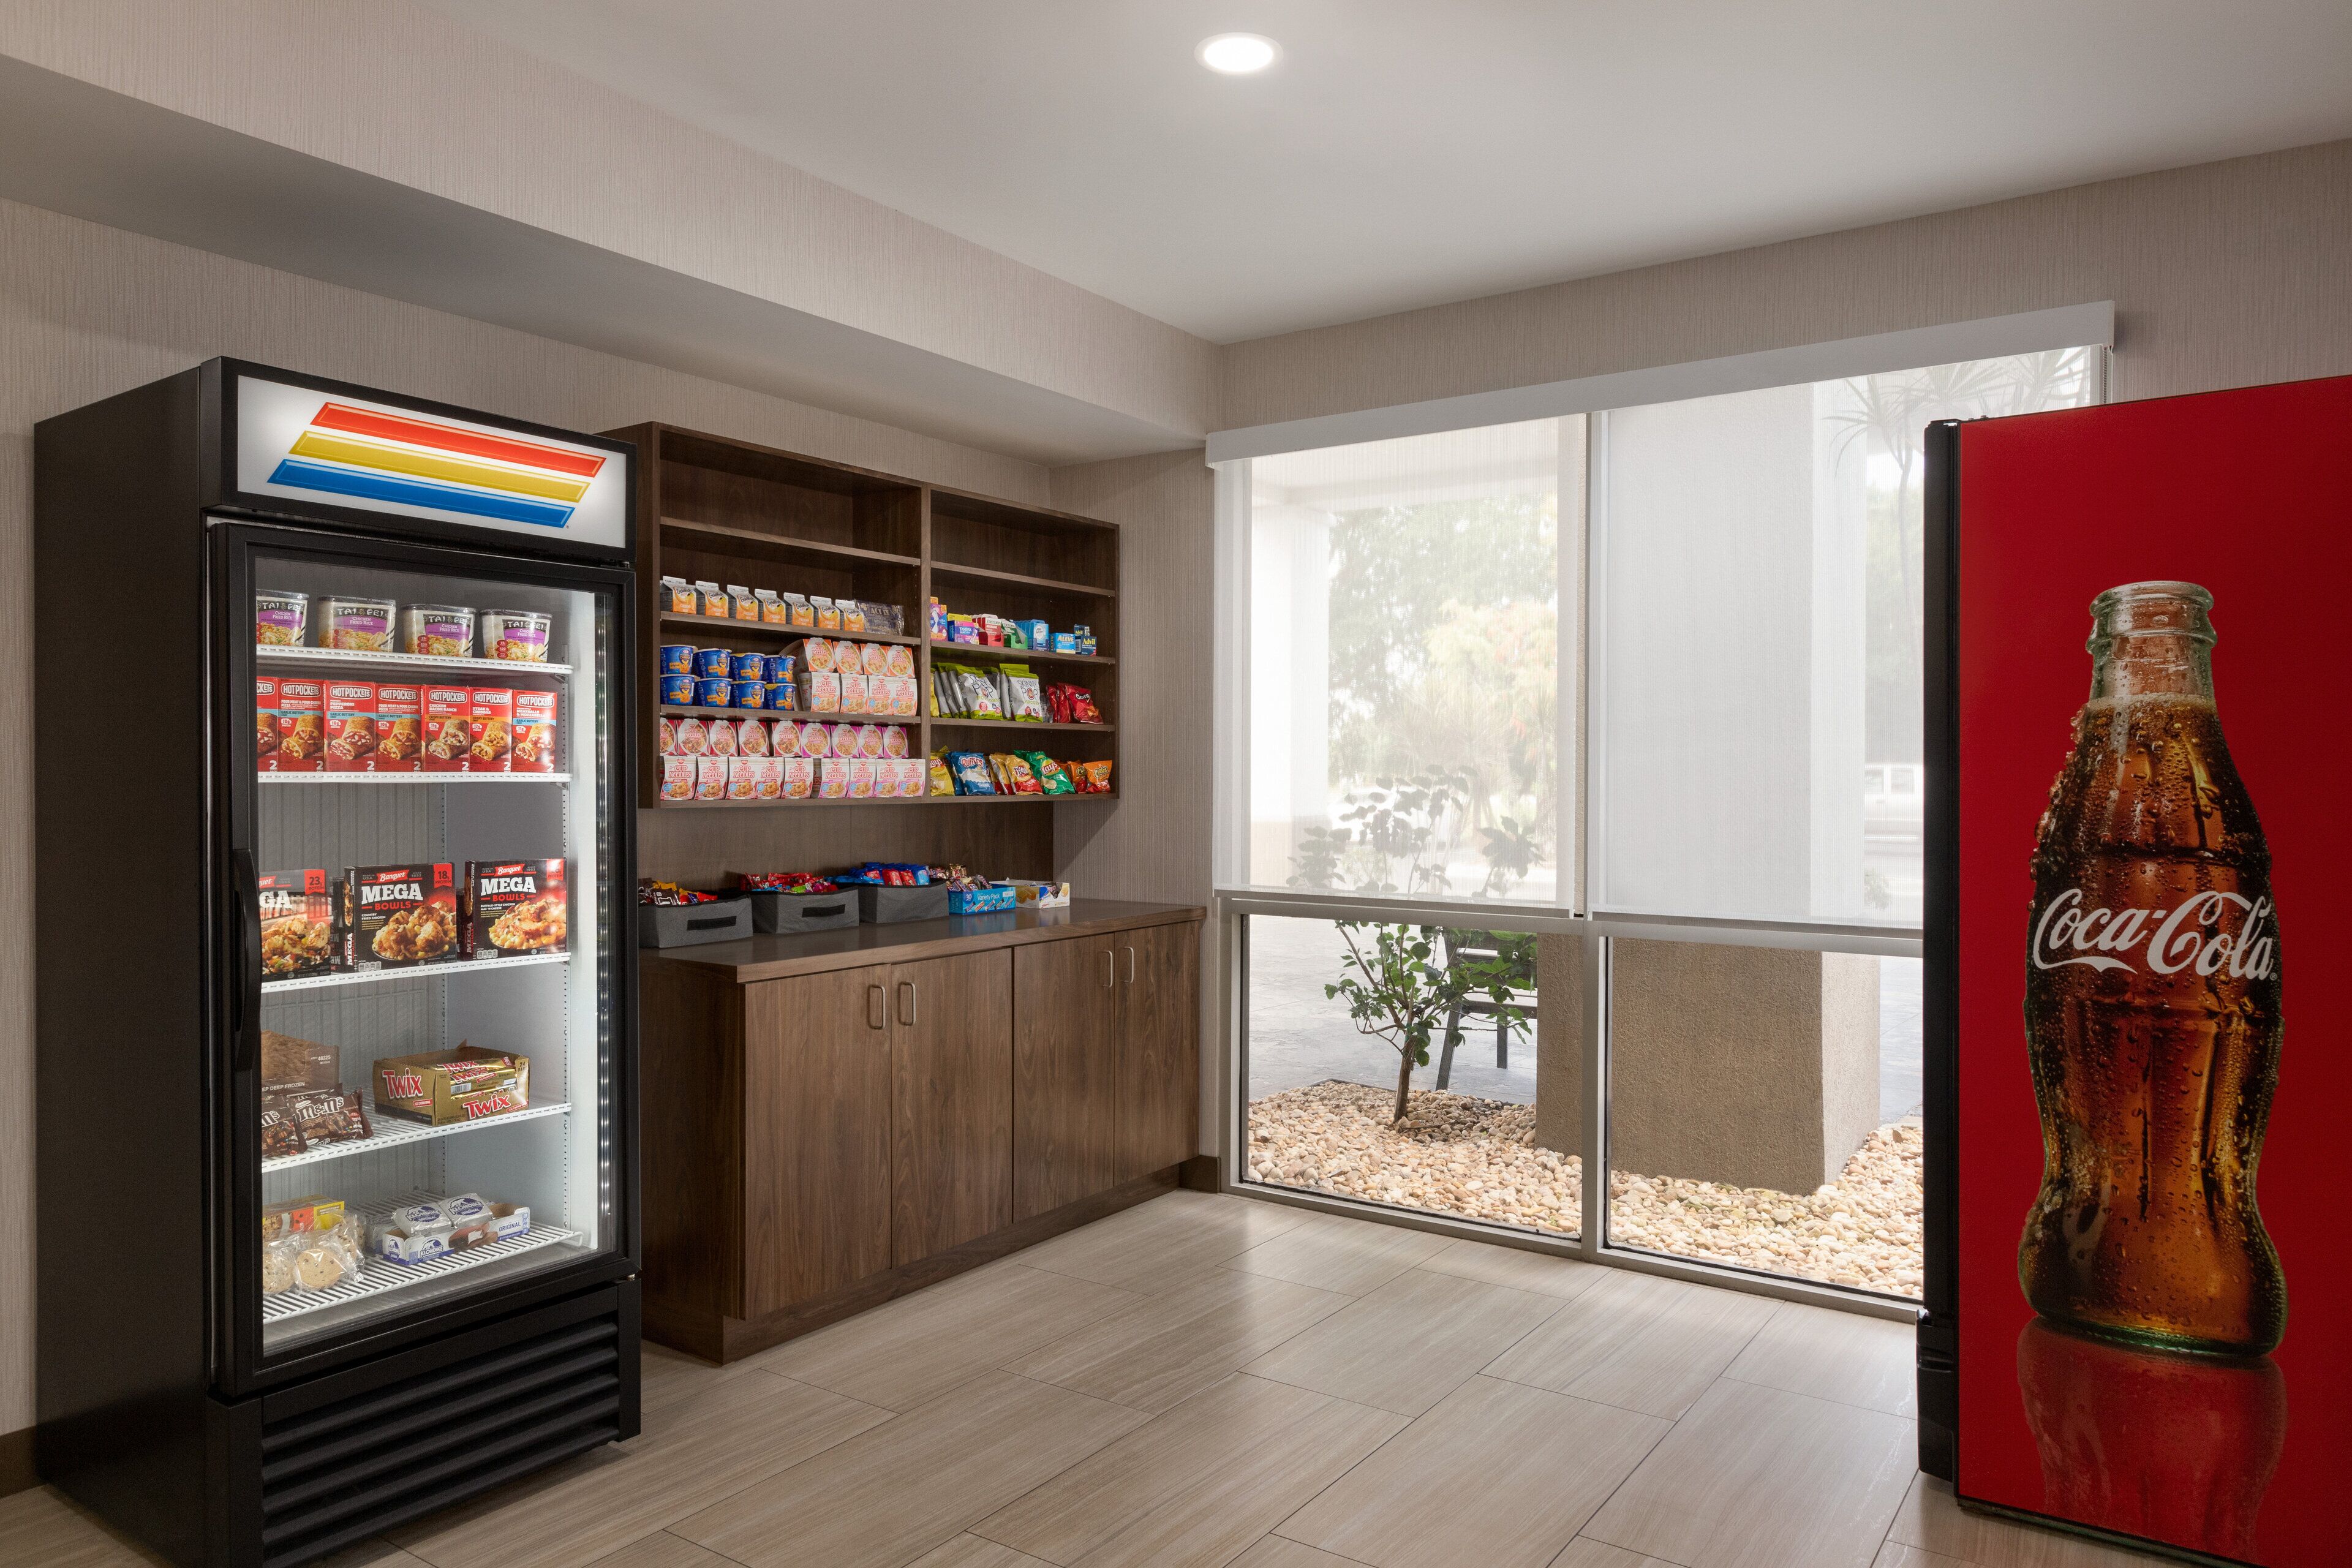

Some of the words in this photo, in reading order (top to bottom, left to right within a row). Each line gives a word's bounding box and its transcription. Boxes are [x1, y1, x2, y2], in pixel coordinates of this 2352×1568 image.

[257, 683, 273, 693] CKETS
[497, 865, 521, 875] Banquet
[380, 872, 405, 882] Banquet
[481, 876, 537, 896] MEGA
[361, 883, 423, 905] MEGA
[259, 890, 292, 910] GA
[375, 901, 411, 910] BOWLS
[2033, 888, 2274, 980] Coca-Cola
[499, 1221, 521, 1232] ORIGINAL
[420, 1245, 443, 1257] KLONDIKE
